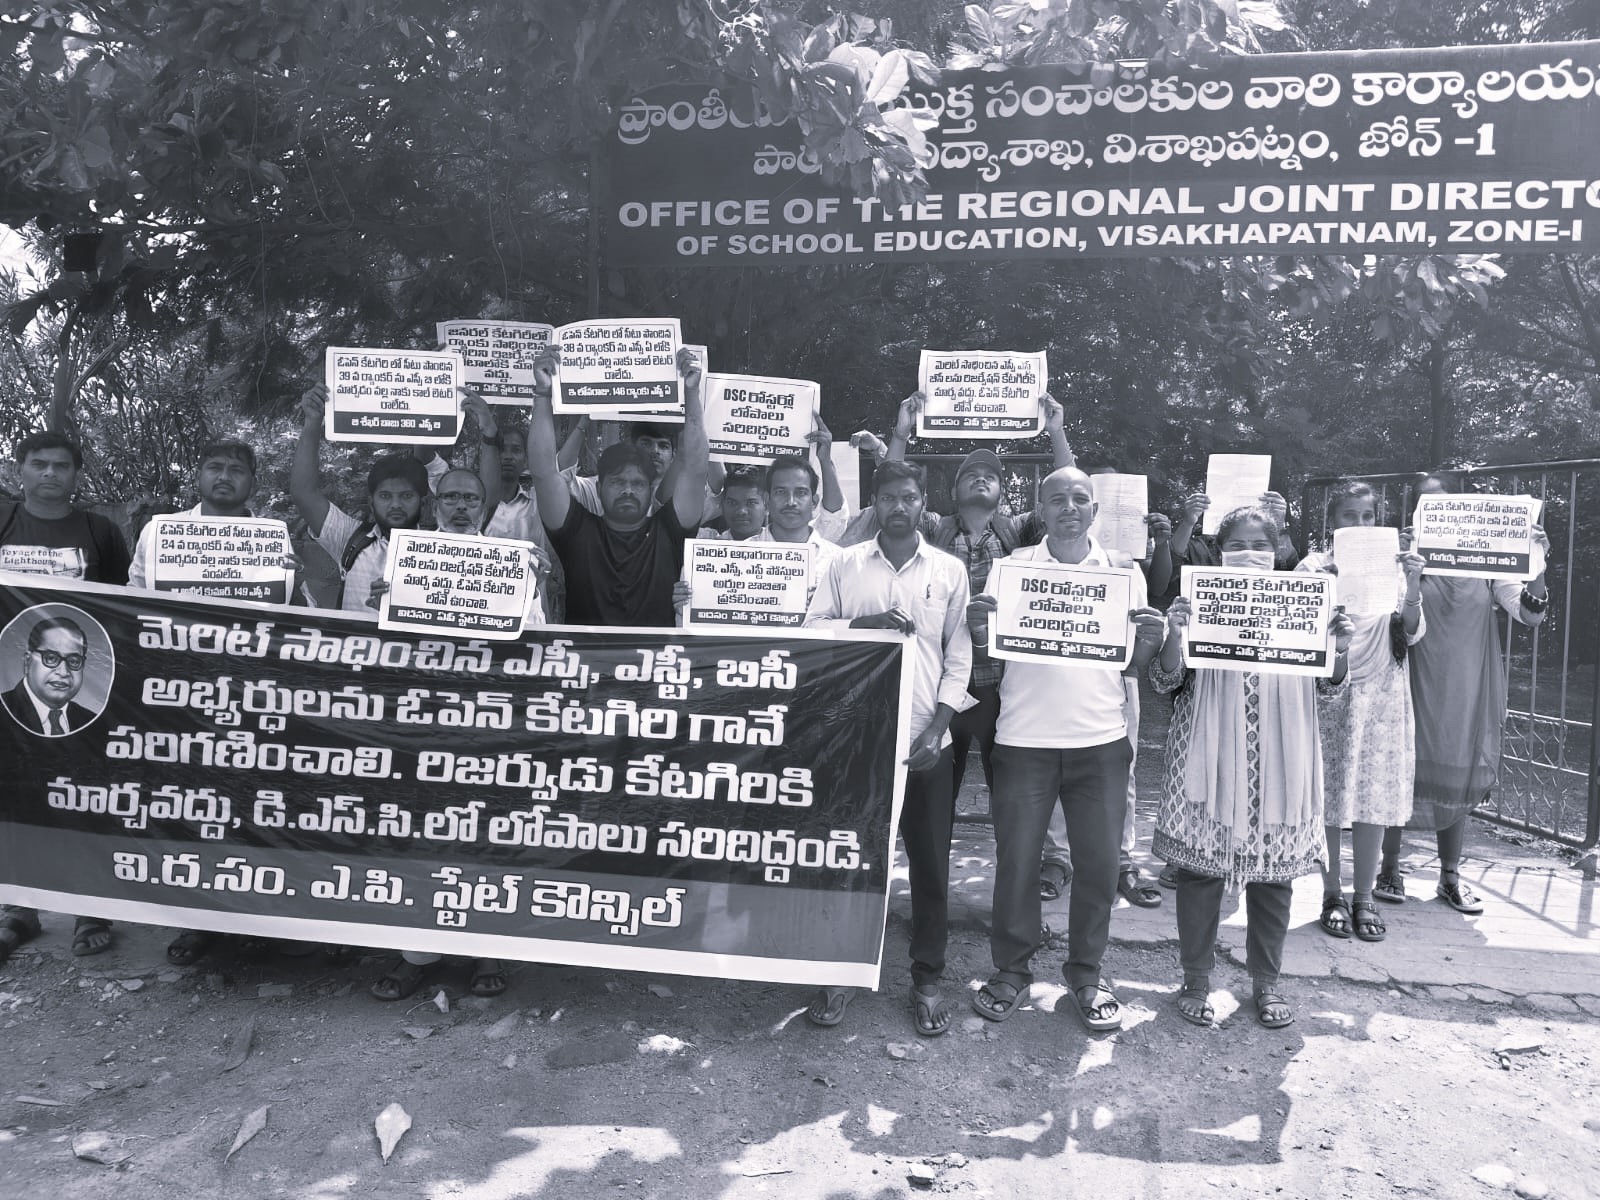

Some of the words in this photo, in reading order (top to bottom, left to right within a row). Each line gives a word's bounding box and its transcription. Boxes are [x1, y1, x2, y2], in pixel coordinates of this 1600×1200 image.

[985, 76, 1234, 119] సంచాలకుల
[1244, 72, 1341, 110] వారి
[1352, 59, 1600, 118] కార్యాలయ
[1103, 124, 1338, 170] విశాఖపట్నం,
[1359, 115, 1442, 157] జోన్
[618, 199, 770, 227] OFFICE
[783, 197, 840, 224] OF
[957, 187, 1205, 222] REGIONAL
[1217, 184, 1375, 215] JOINT
[677, 235, 718, 256] OF
[728, 233, 863, 255] SCHOOL
[873, 227, 1087, 252] EDUCATION,
[1099, 221, 1436, 248] VISAKHAPATNAM,
[1447, 219, 1582, 242] ZONE-I
[724, 388, 747, 402] DSC
[162, 539, 174, 550] 24
[1021, 577, 1048, 594] DSC
[1029, 597, 1093, 616] లోపాలు
[138, 615, 276, 658] మెరిట్
[280, 628, 494, 672] సాధించిన
[503, 639, 600, 689] ఎస్సీ,
[615, 645, 702, 700] ఎస్టీ,
[526, 692, 678, 740] కేటగిరి
[689, 705, 789, 746] గానే
[106, 726, 402, 779] పరిగణించాలి.
[626, 754, 814, 807] కేటగిరికి
[489, 805, 648, 854] లోపాలు
[657, 821, 871, 883] సరిదిద్దండి.
[431, 866, 523, 928] స్టేట్
[530, 880, 687, 936] కౌన్సిల్
